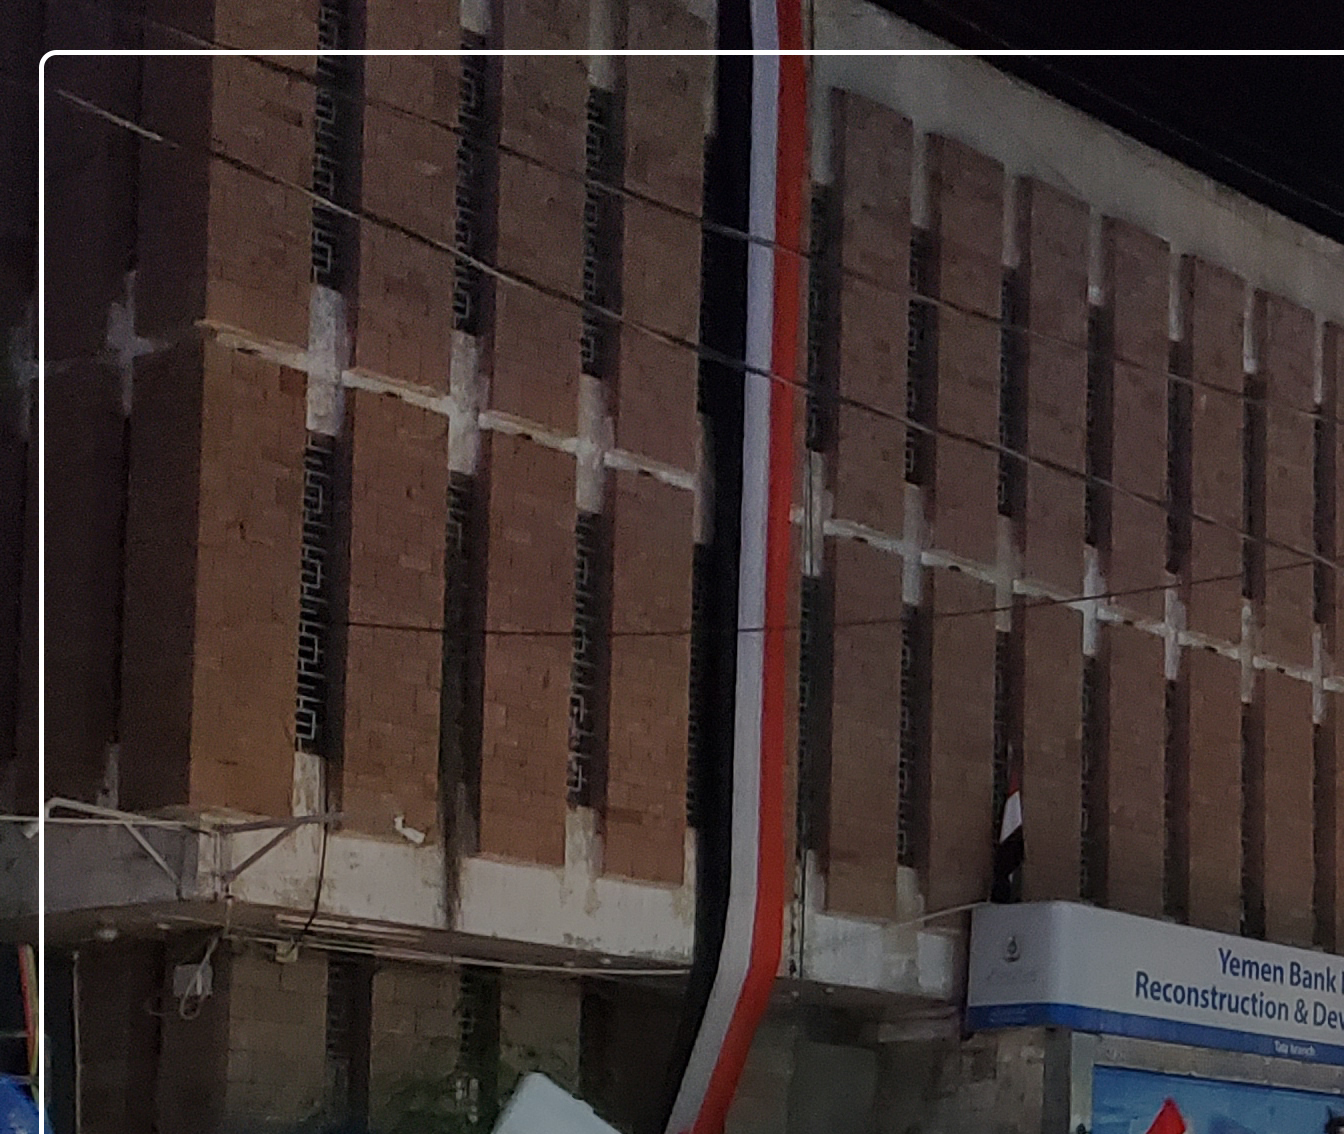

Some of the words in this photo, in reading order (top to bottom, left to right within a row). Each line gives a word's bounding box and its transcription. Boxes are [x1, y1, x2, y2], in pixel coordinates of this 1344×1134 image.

[1218, 947, 1284, 985] Yemen
[1289, 961, 1336, 994] Bank
[1135, 971, 1289, 1022] Reconstruction
[1295, 999, 1308, 1025] &
